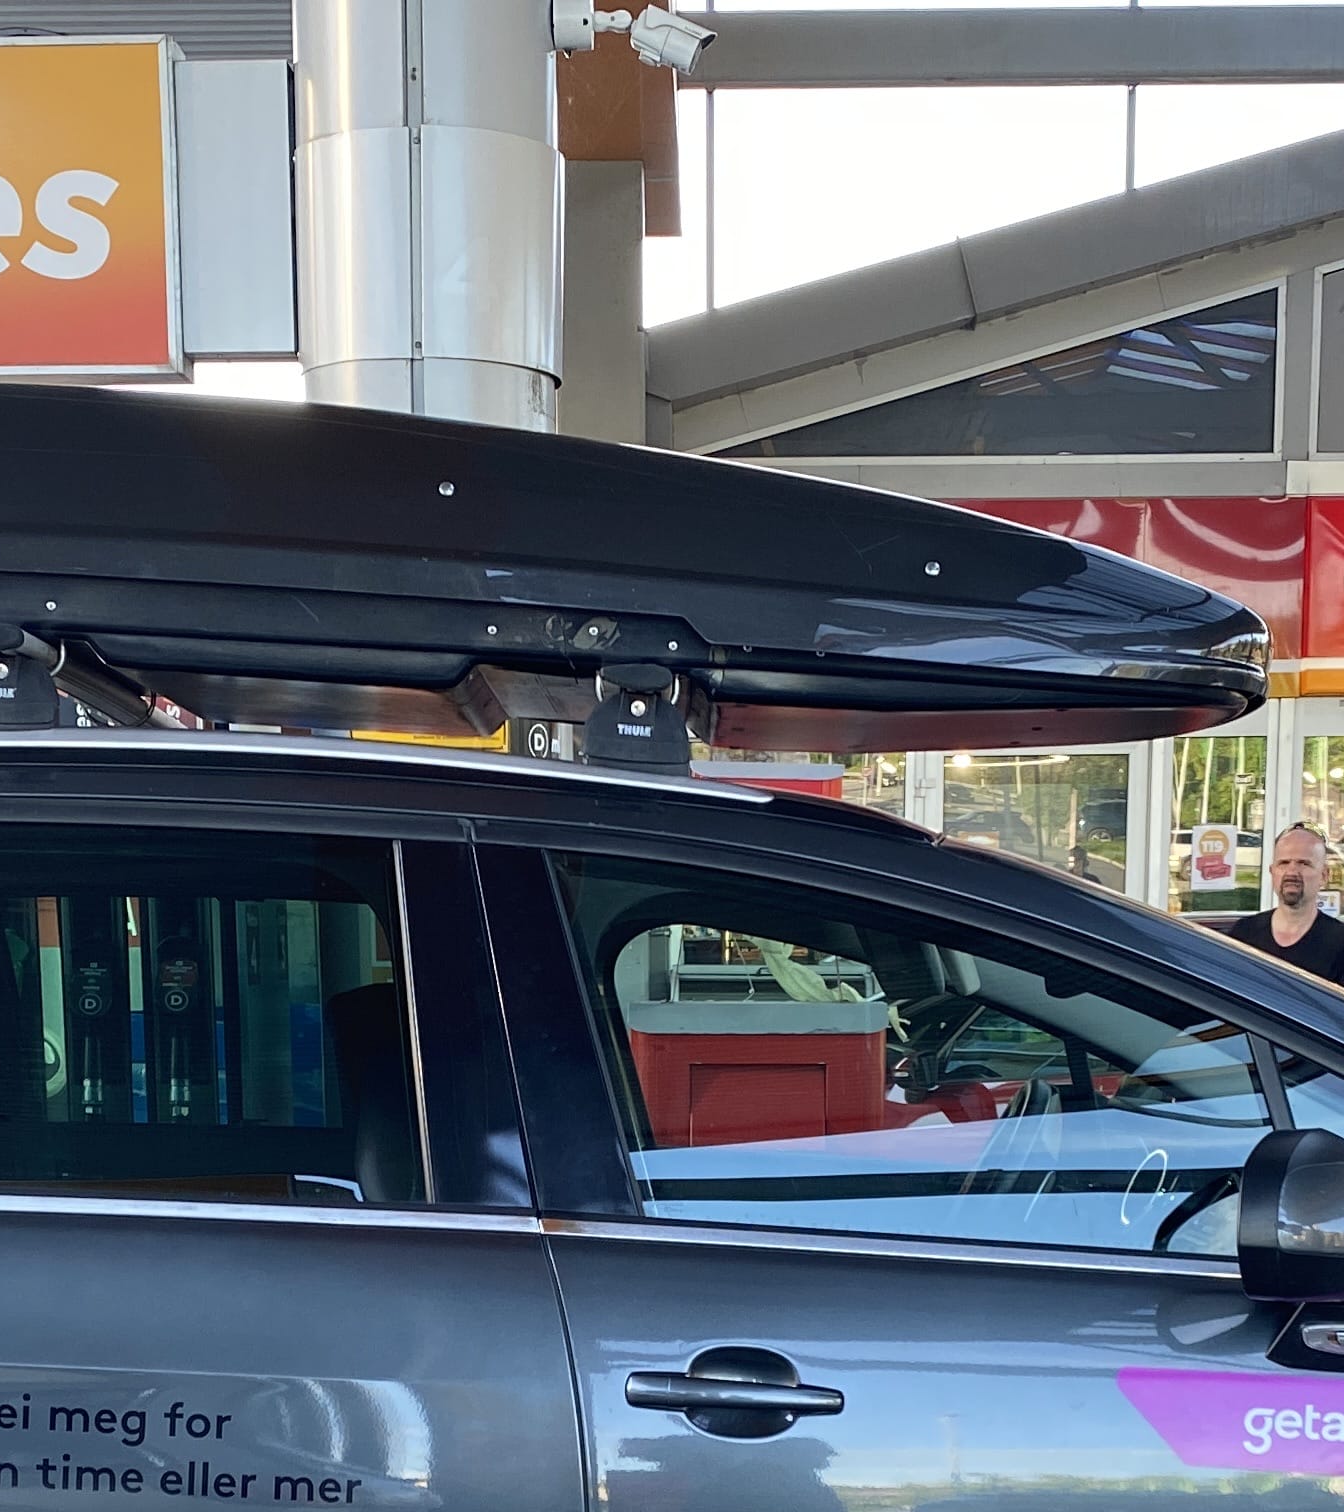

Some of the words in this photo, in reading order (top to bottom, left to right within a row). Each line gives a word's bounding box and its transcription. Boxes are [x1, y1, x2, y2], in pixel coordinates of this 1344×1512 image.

[533, 733, 546, 751] D
[1201, 839, 1225, 853] 119
[49, 1405, 148, 1447] meg
[163, 1401, 232, 1440] for
[36, 1453, 144, 1494] time
[160, 1460, 257, 1499] eller
[274, 1474, 362, 1504] mer
